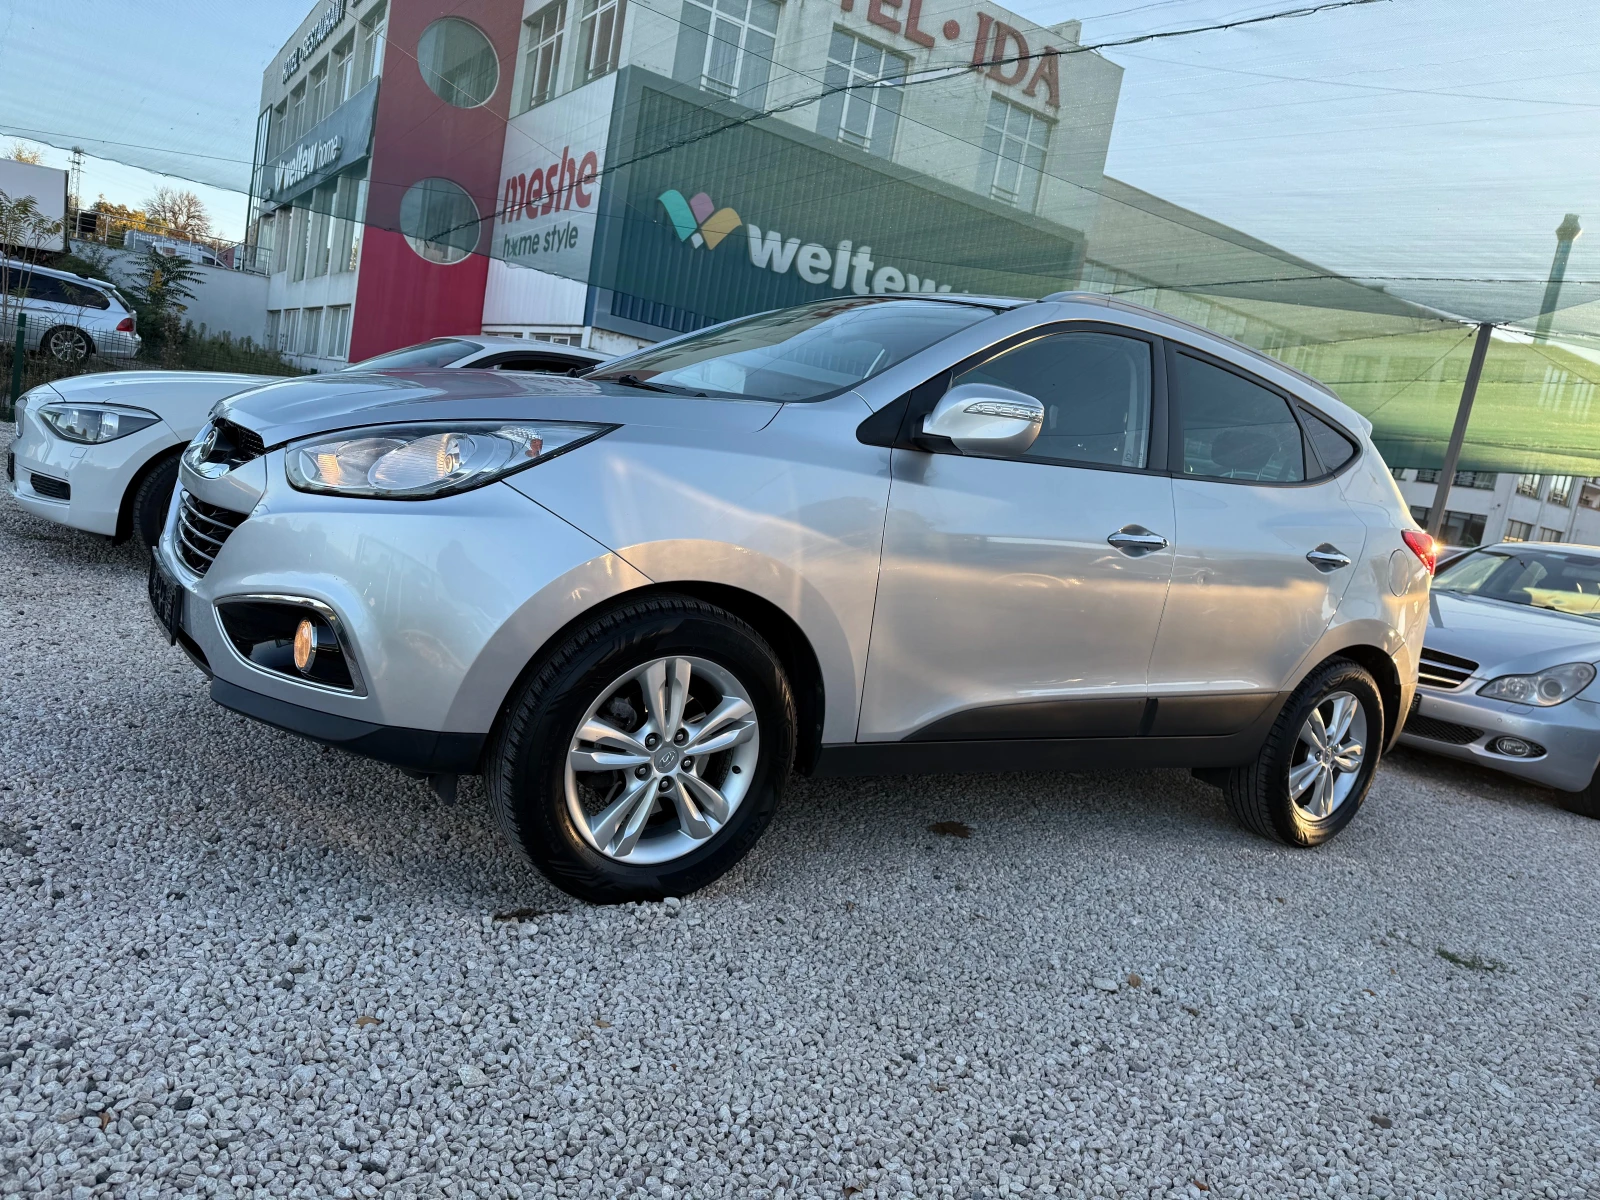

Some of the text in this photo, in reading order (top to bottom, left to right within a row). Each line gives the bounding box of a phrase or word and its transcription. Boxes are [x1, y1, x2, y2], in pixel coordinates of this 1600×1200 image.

[972, 12, 1061, 108] IDA
[317, 135, 339, 170] home
[501, 145, 598, 225] meshe
[543, 221, 579, 253] style
